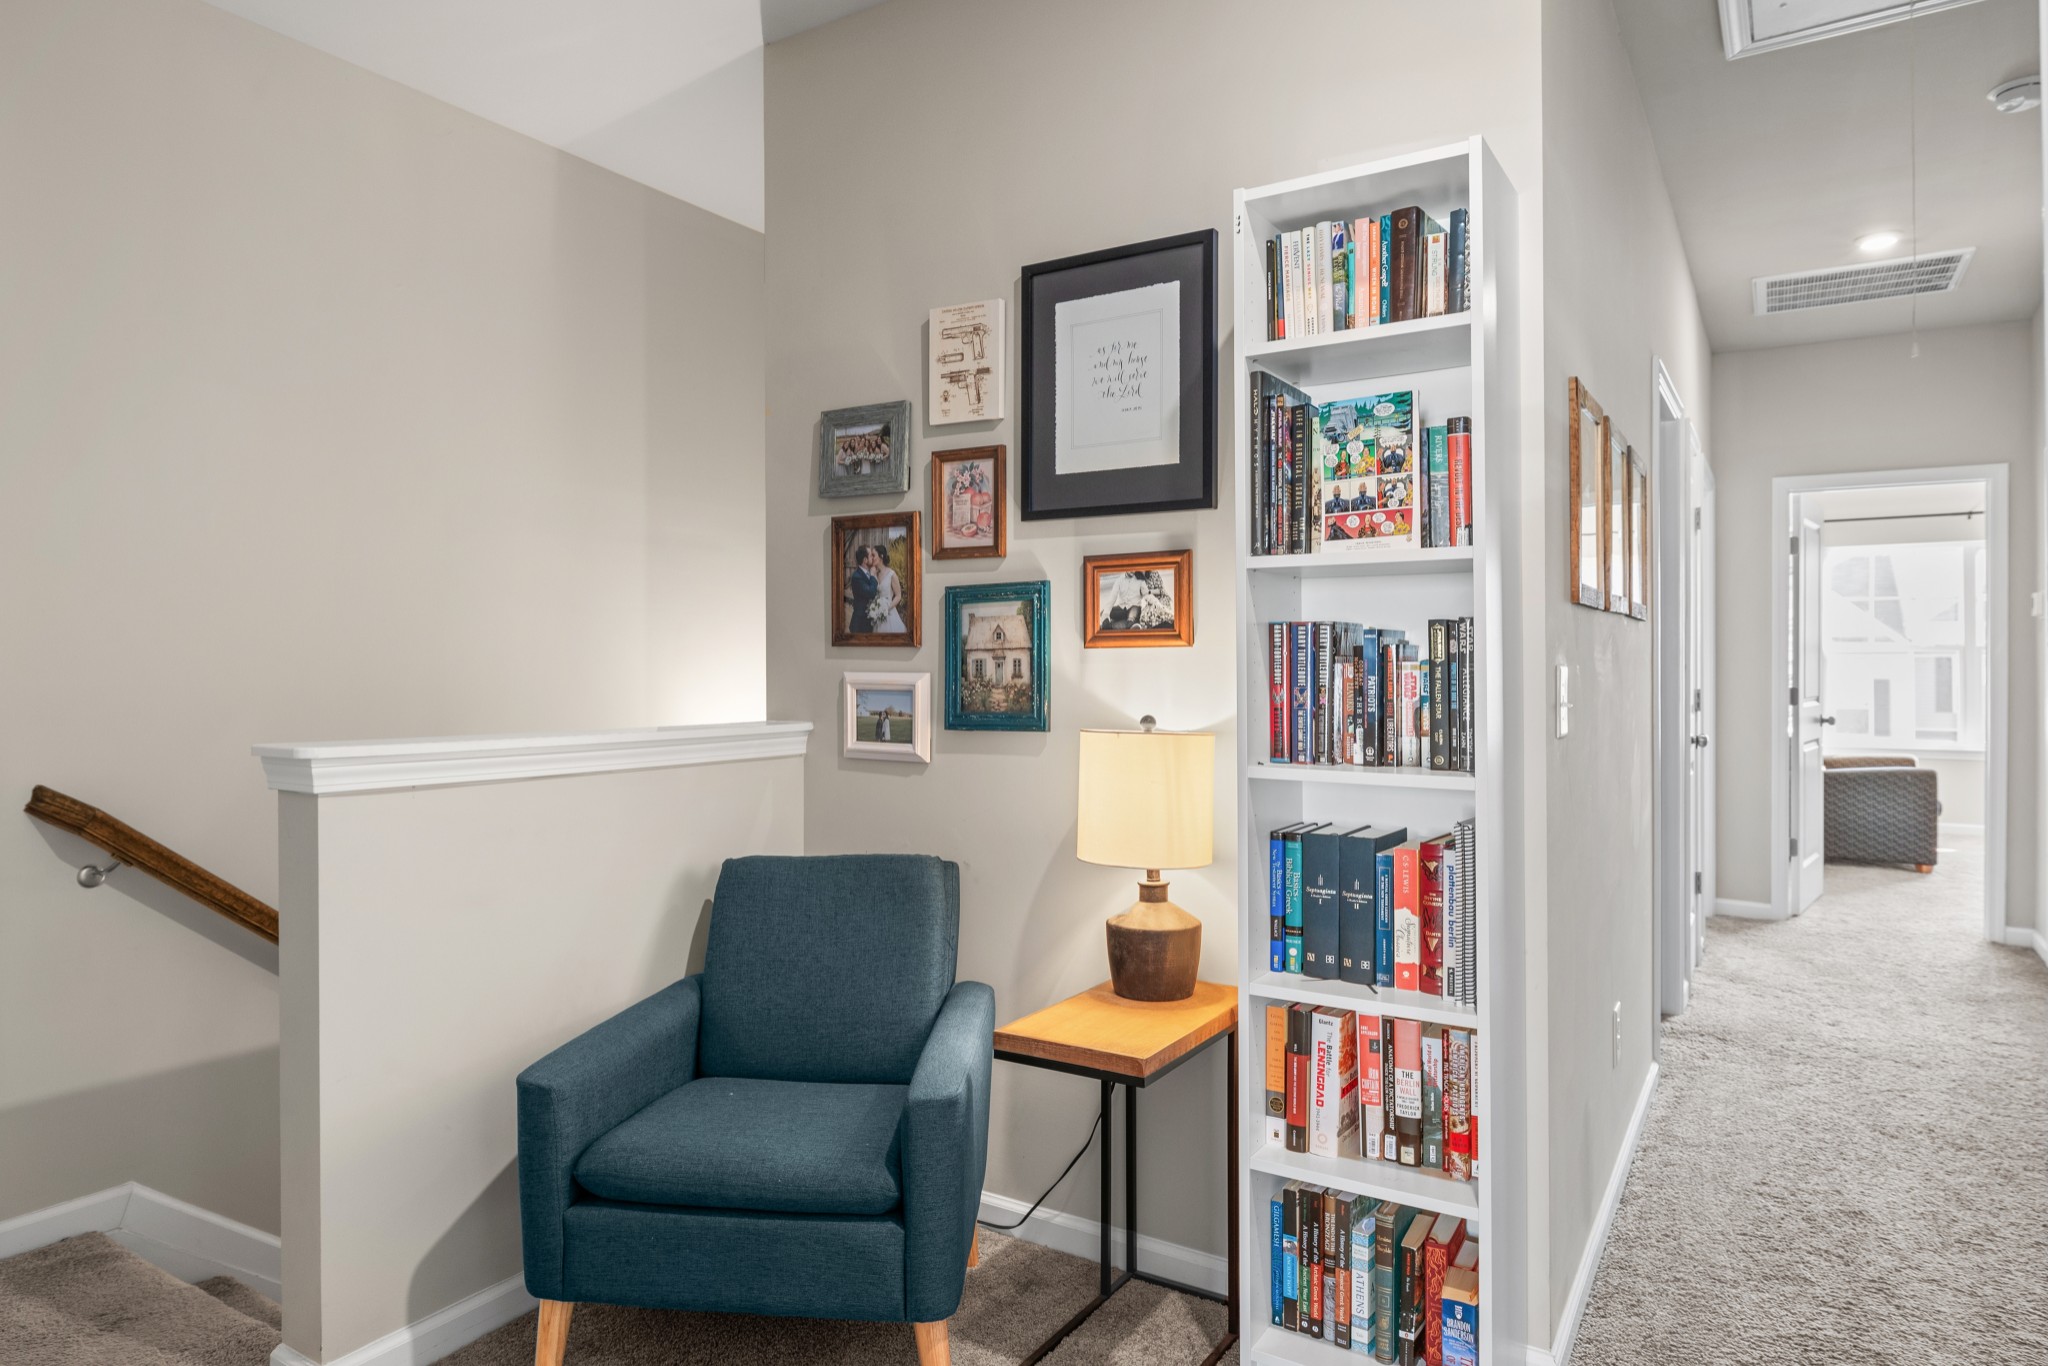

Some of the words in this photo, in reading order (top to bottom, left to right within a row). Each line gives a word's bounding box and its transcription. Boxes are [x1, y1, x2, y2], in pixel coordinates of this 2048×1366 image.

[1292, 240, 1300, 270] FERVENT
[1127, 350, 1148, 368] house
[1117, 383, 1142, 402] Lord
[1253, 389, 1261, 416] HALO
[1296, 430, 1303, 439] IN
[1434, 434, 1443, 464] RIVERS
[1295, 482, 1303, 510] ISRAEL
[1273, 624, 1283, 647] HARRY
[1297, 625, 1306, 648] HARRY
[1319, 624, 1328, 647] HARRY
[1459, 621, 1467, 654] WARS
[1273, 647, 1283, 686] TURTLEDOVE
[1297, 649, 1306, 687] TURTLEDOVE
[1319, 648, 1328, 687] TURTLEDOVE
[1367, 674, 1376, 713] PATRIOTS
[1462, 667, 1471, 722] ALLEGIANCE
[1386, 717, 1394, 752] LIBERATORS
[1285, 857, 1293, 887] Biblical
[1293, 872, 1301, 897] Basics
[1306, 886, 1336, 895] Septuaginta
[1342, 890, 1374, 900] Septuaginta
[1447, 864, 1457, 917] plattenbau
[1285, 889, 1293, 915] Greek
[1422, 900, 1443, 908] COMEDY
[1424, 895, 1443, 903] DIVINE
[1396, 929, 1405, 958] Classics
[1401, 917, 1416, 956] Signature
[1448, 919, 1457, 949] berlin
[1318, 1018, 1334, 1027] Glantz
[1326, 1031, 1334, 1043] The
[1325, 1044, 1333, 1066] Battle
[1452, 1050, 1460, 1082] AMERICAN
[1459, 1045, 1467, 1079] AMERICAN
[1315, 1040, 1326, 1108] LENINGRAD
[1362, 1078, 1380, 1091] CURTAIN
[1368, 1067, 1380, 1080] IRON
[1396, 1078, 1421, 1088] BERLIN
[1401, 1070, 1415, 1080] THE
[1399, 1087, 1417, 1097] WALL
[1452, 1084, 1460, 1116] PATRIOTS
[1458, 1079, 1467, 1122] INSURGENTS,
[1388, 1089, 1396, 1131] DICTATORSHIP
[1396, 1103, 1421, 1111] FREDERICK
[1400, 1109, 1417, 1117] TAYLOR
[1273, 1204, 1281, 1247] GILGAMESH
[1312, 1228, 1320, 1247] History
[1303, 1249, 1308, 1257] of
[1313, 1247, 1320, 1255] of
[1339, 1251, 1346, 1259] of
[1356, 1272, 1365, 1316] ATHENS
[1443, 1327, 1474, 1344] SANDERSON
[1446, 1317, 1472, 1333] BRANDON
